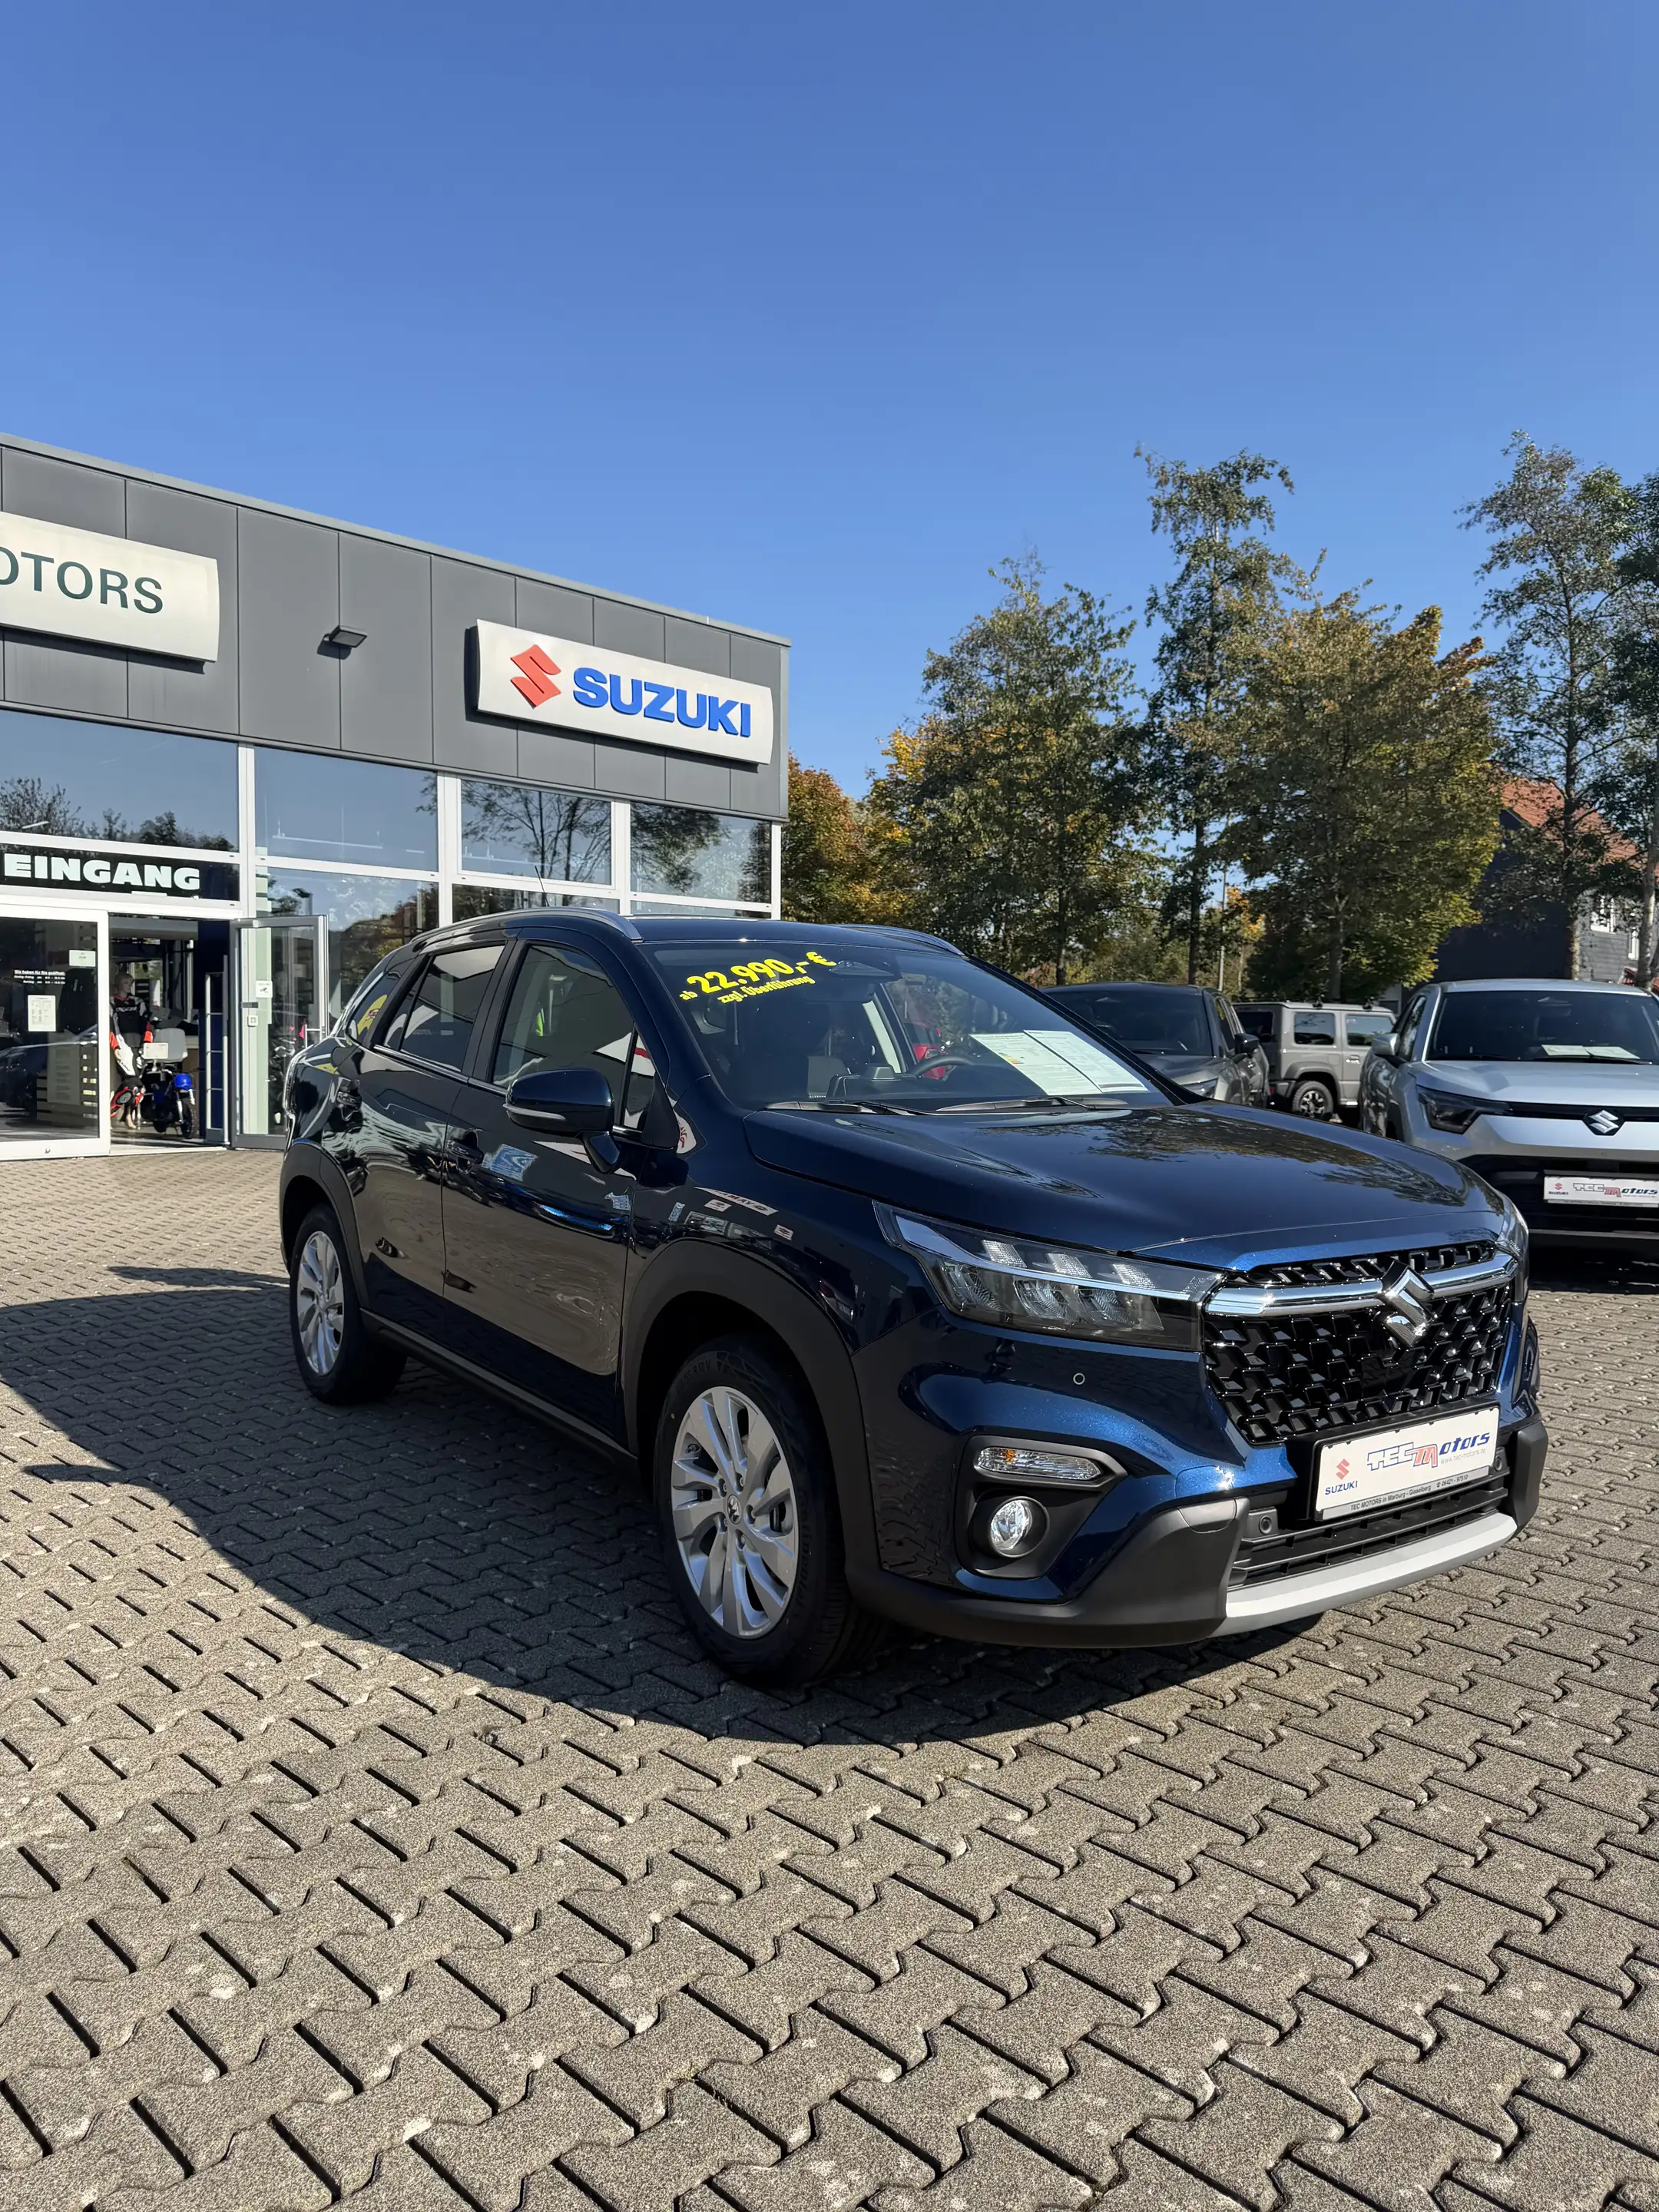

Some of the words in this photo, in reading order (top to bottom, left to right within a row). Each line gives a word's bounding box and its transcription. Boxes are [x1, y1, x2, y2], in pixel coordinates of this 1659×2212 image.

[573, 667, 751, 738] SUZUKI
[4, 853, 200, 891] EINGANG
[679, 990, 698, 1001] ab
[806, 951, 837, 967] €
[740, 975, 816, 996] Überführung
[1324, 1480, 1358, 1495] SUZUKI
[1361, 1497, 1382, 1509] MOTORS
[1387, 1492, 1406, 1502] Marburg
[1409, 1485, 1432, 1495] Gisselberg
